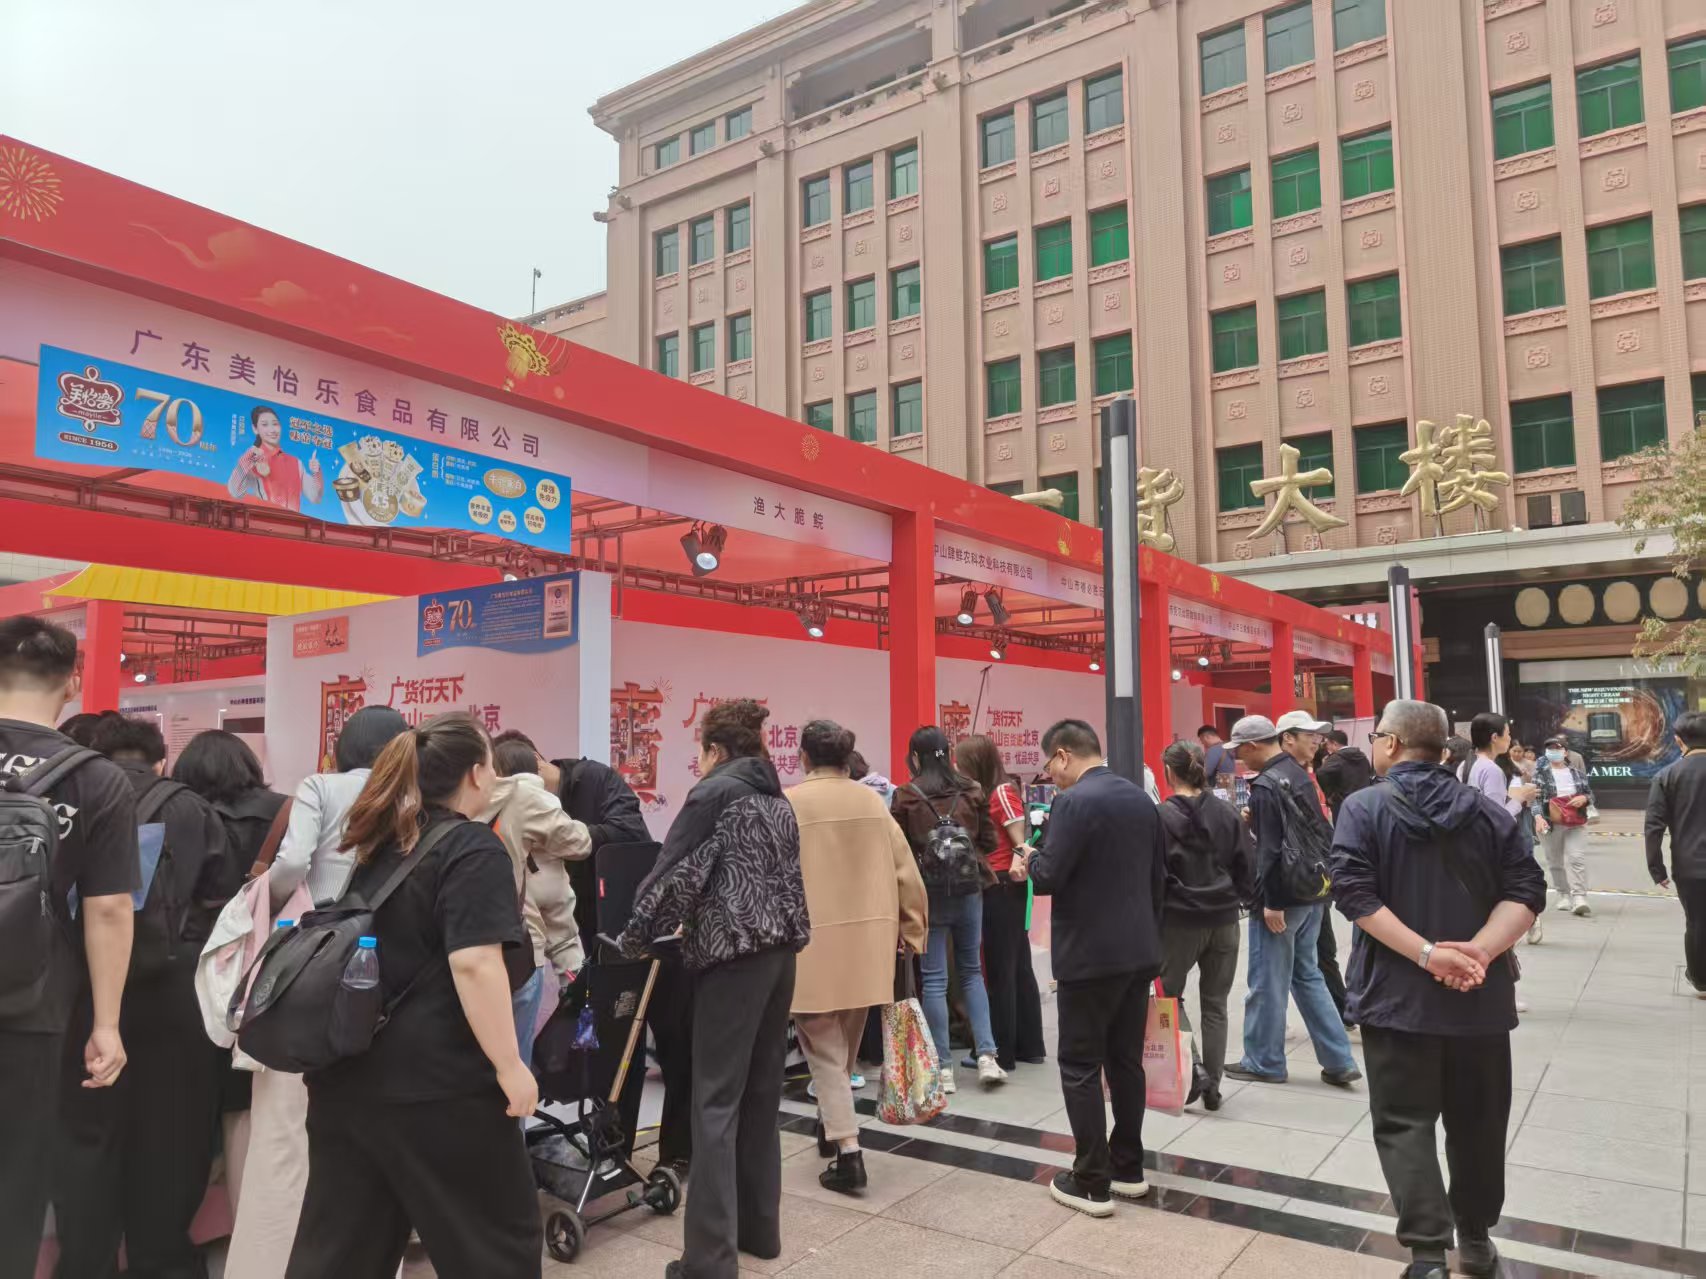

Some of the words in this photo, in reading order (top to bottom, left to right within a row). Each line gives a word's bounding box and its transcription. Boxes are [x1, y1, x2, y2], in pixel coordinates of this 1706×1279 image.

[130, 329, 540, 458] 广东美怡乐食品有限公司
[134, 387, 203, 446] 70
[753, 496, 824, 530] 渔大脆鲩
[448, 600, 473, 632] 70
[388, 672, 465, 708] 广货行天下
[985, 706, 1023, 727] 广货行天下
[1601, 766, 1632, 777] MER
